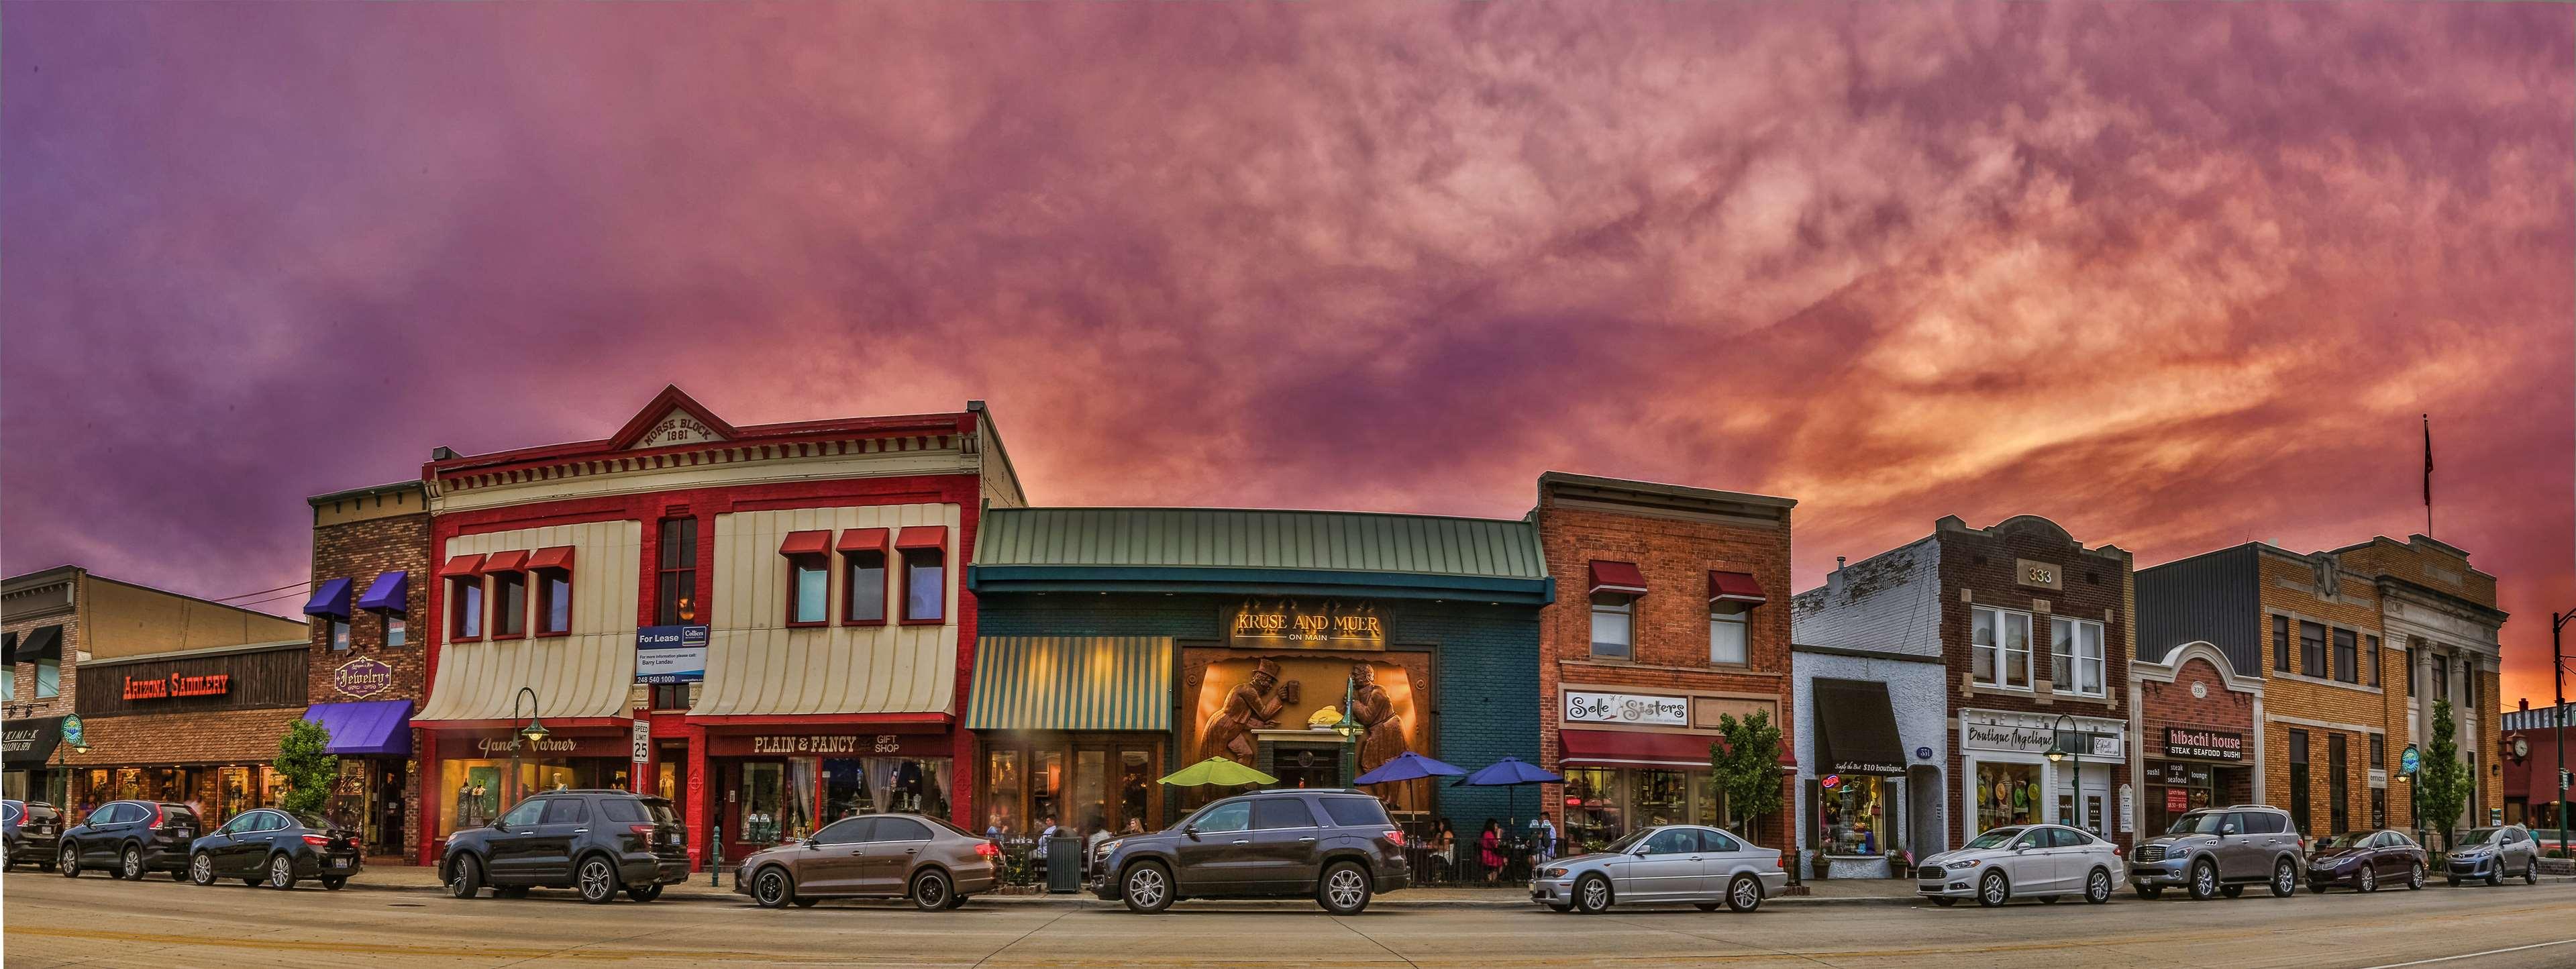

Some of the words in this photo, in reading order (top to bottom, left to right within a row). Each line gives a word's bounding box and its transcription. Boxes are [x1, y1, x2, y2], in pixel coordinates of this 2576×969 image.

[644, 419, 676, 446] MORSE
[680, 419, 711, 440] BLOCK
[667, 429, 688, 441] 1881
[2029, 567, 2051, 583] 333
[1237, 614, 1287, 629] KRUSE
[1292, 615, 1328, 629] AND
[1333, 617, 1379, 631] MUER
[340, 668, 384, 687] Jewelry
[123, 676, 166, 700] ARIZONA
[172, 672, 228, 697] SADDLERY
[1569, 697, 1610, 718] Sole
[1623, 699, 1684, 721] Sisters
[530, 738, 577, 752] Varner
[754, 737, 796, 752] PLAIN
[798, 738, 808, 750] &
[811, 736, 856, 752] FANCY
[877, 735, 896, 744] GIFT
[1969, 727, 2010, 744] Boutique
[2011, 728, 2052, 750] Angelique
[2171, 730, 2208, 746] hibachi
[2212, 733, 2240, 749] house
[635, 742, 647, 758] 25
[875, 744, 899, 752] SHOP
[2194, 748, 2220, 756] SEAFOOD
